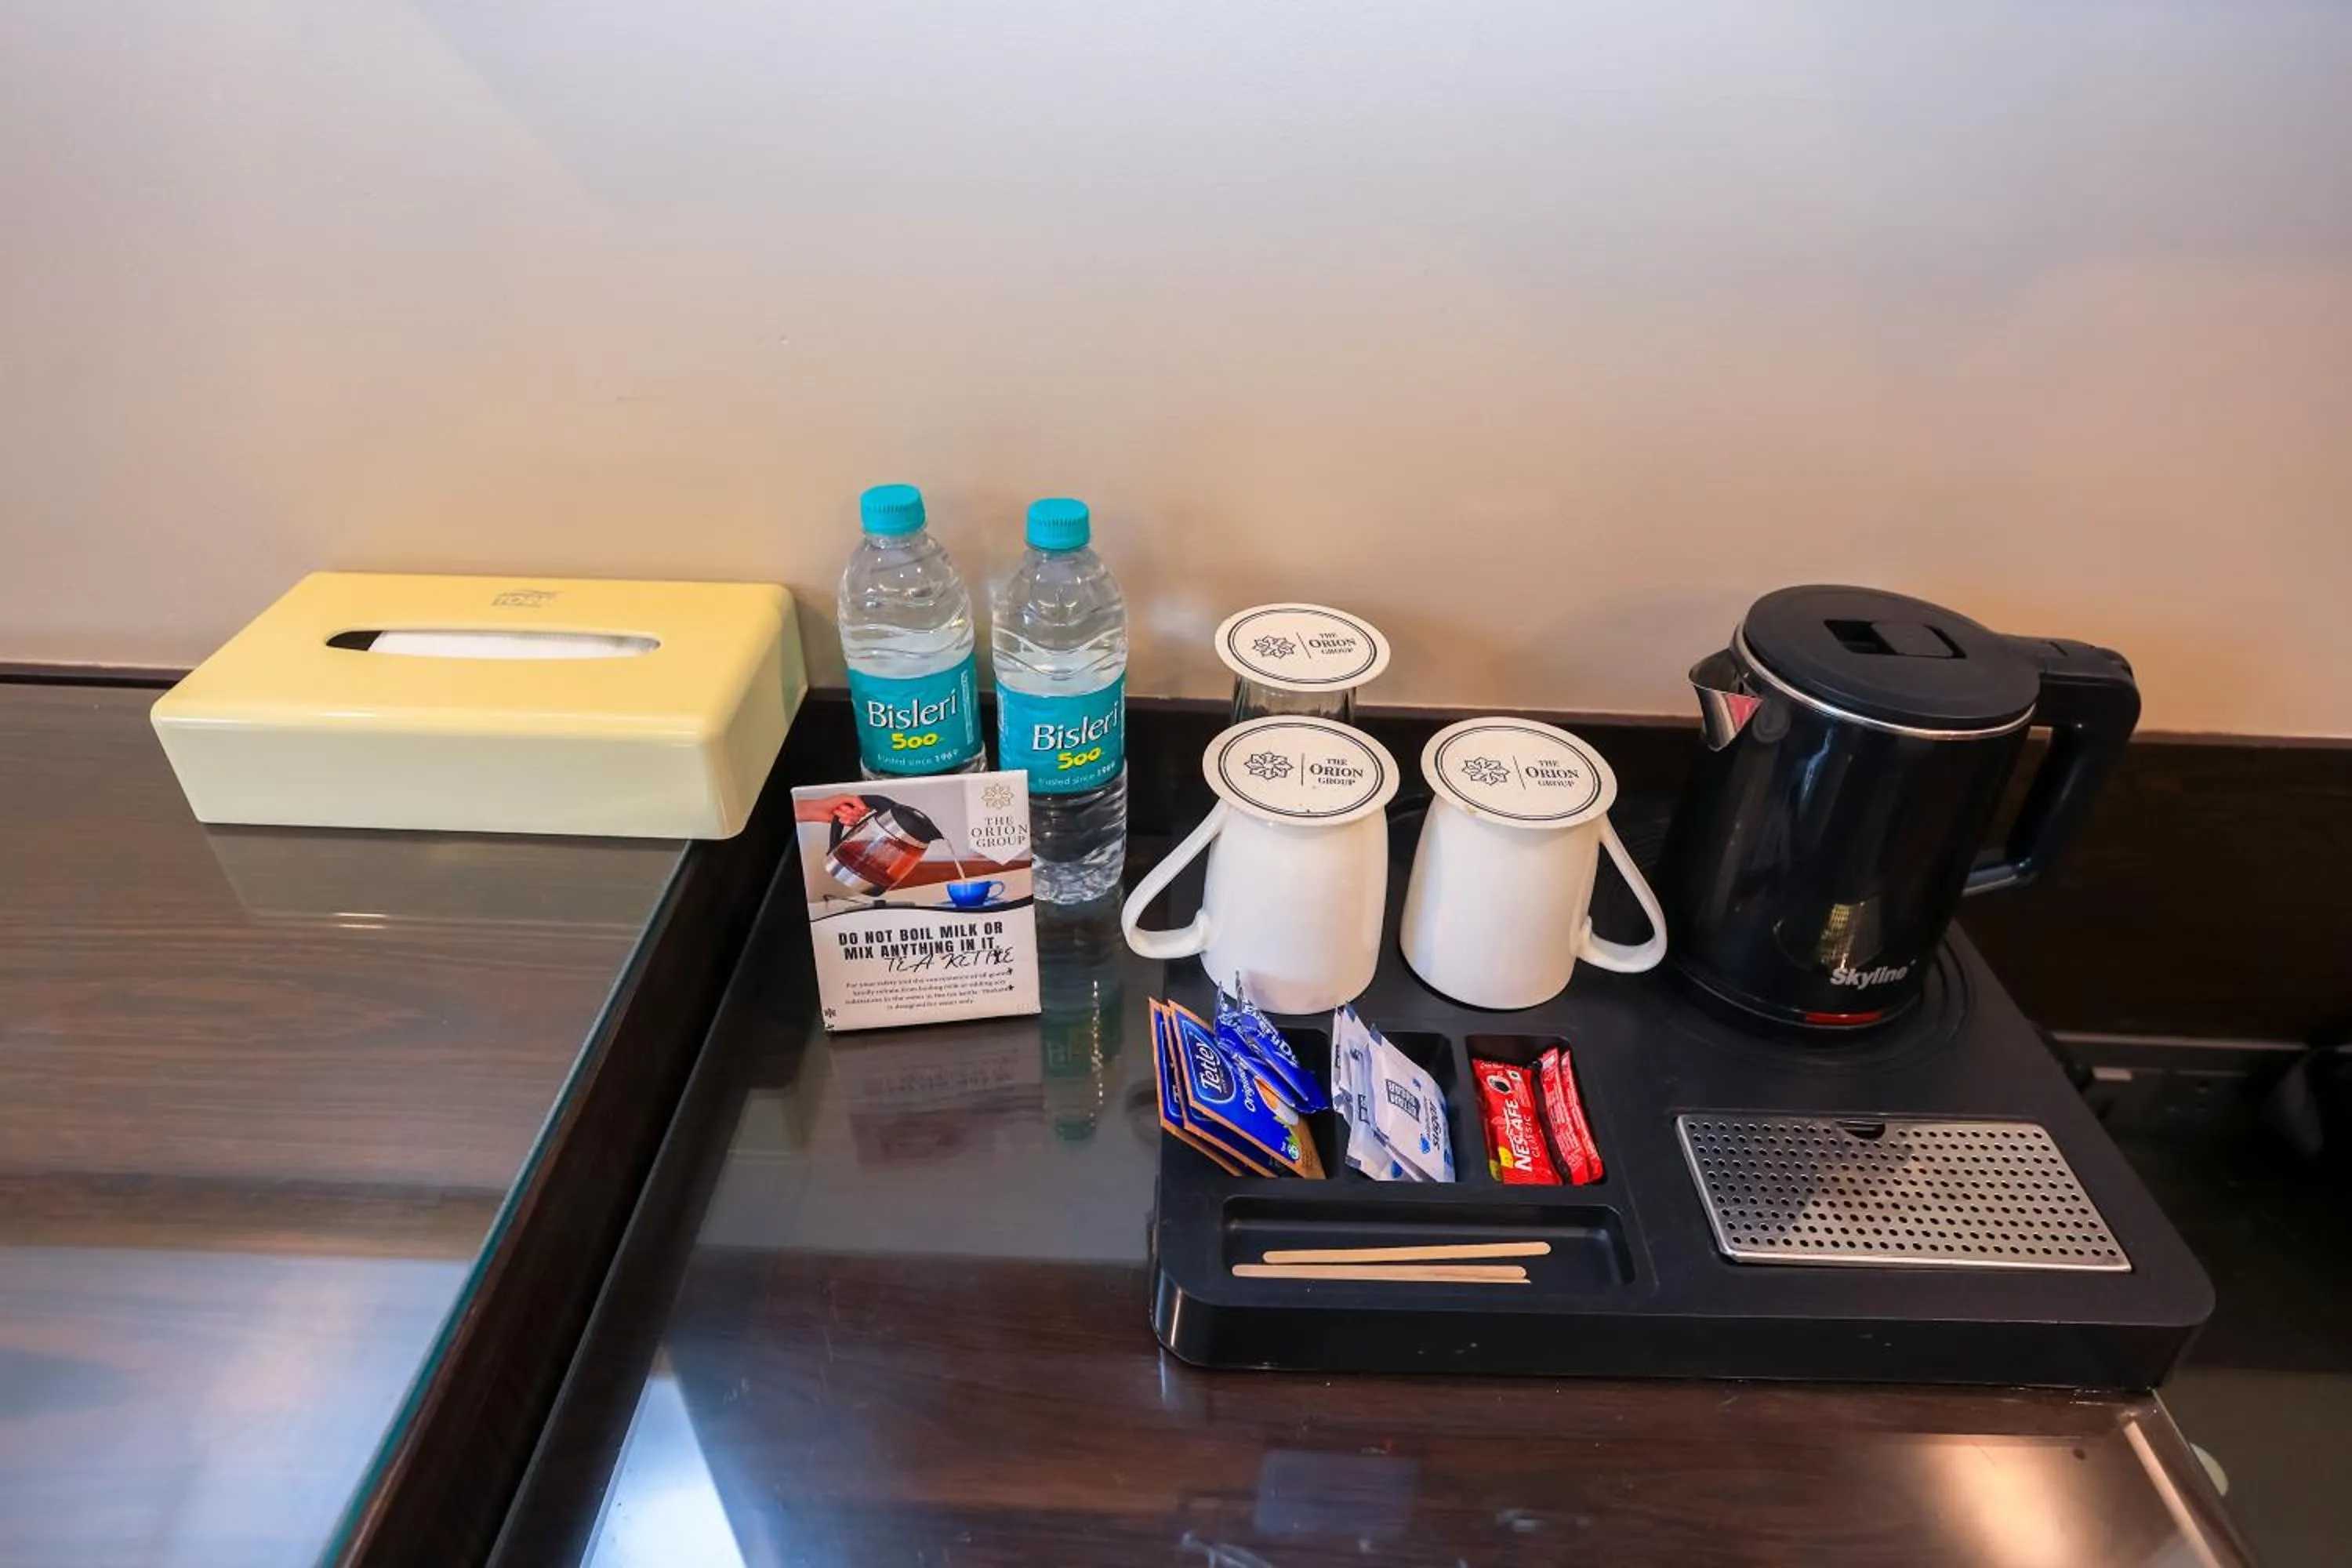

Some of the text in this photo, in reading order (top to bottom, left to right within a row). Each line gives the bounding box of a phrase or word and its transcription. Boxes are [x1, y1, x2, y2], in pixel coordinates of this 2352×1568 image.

[1308, 638, 1356, 648] ORION
[867, 688, 956, 730] Bisleri
[1032, 700, 1119, 751] Bisleri
[891, 732, 938, 750] 500
[1058, 746, 1102, 770] 500
[1309, 764, 1363, 779] ORION
[1525, 766, 1580, 779] ORION
[1318, 777, 1356, 786] GROUP
[985, 816, 1014, 826] THE
[971, 823, 1028, 838] ORION
[976, 835, 1026, 848] GROUP
[838, 921, 1003, 946] DO NOT BOIL MILK OR
[844, 946, 874, 960] MIX
[880, 939, 954, 958] ANYTHING
[960, 938, 975, 951] IN
[1830, 966, 1908, 990] Skyline
[1196, 1042, 1222, 1094] Tetley
